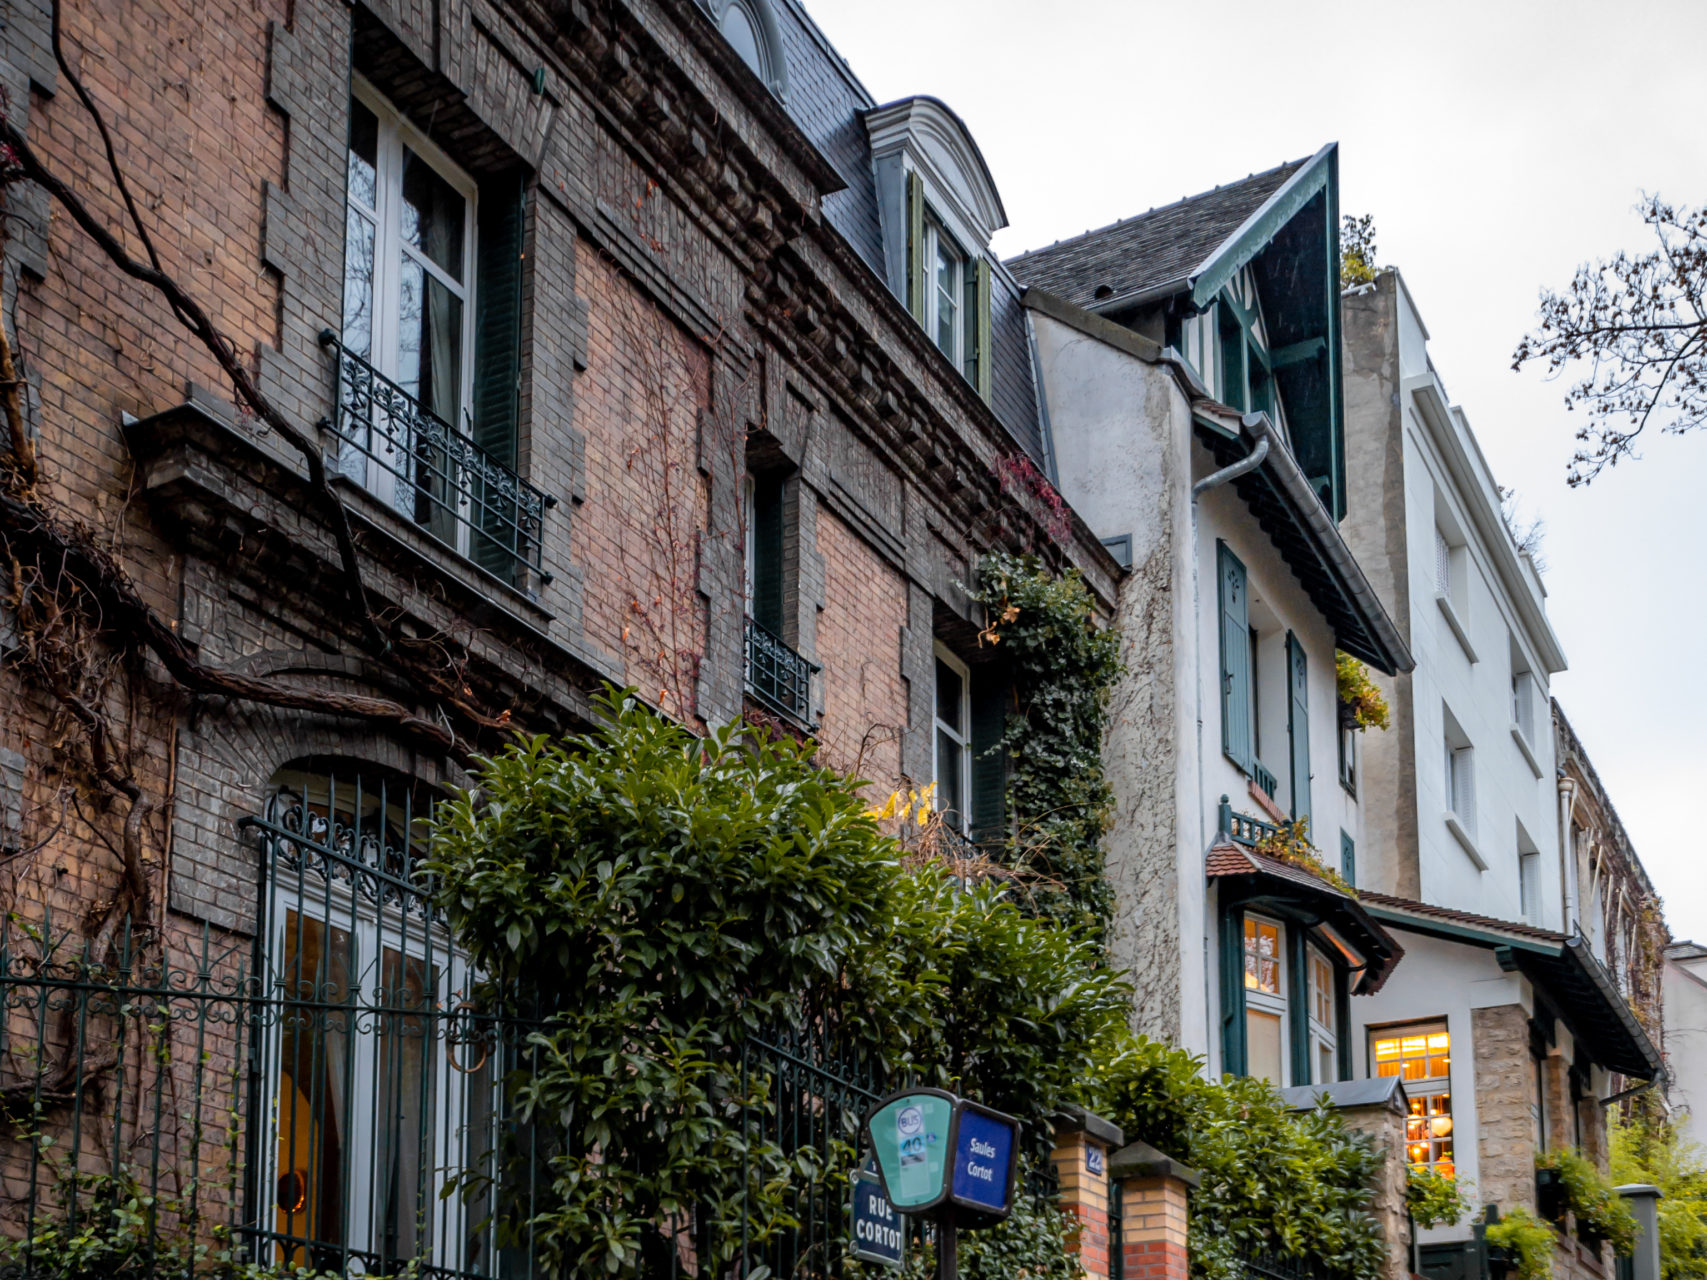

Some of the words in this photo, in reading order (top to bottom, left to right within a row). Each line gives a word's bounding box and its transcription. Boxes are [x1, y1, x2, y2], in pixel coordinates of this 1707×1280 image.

[901, 1114, 919, 1128] BUS
[903, 1137, 922, 1153] 40
[970, 1138, 996, 1158] Saules
[1088, 1146, 1102, 1170] 22
[968, 1161, 992, 1181] Cortot
[869, 1194, 893, 1221] RUE
[856, 1218, 901, 1251] CORTOT
